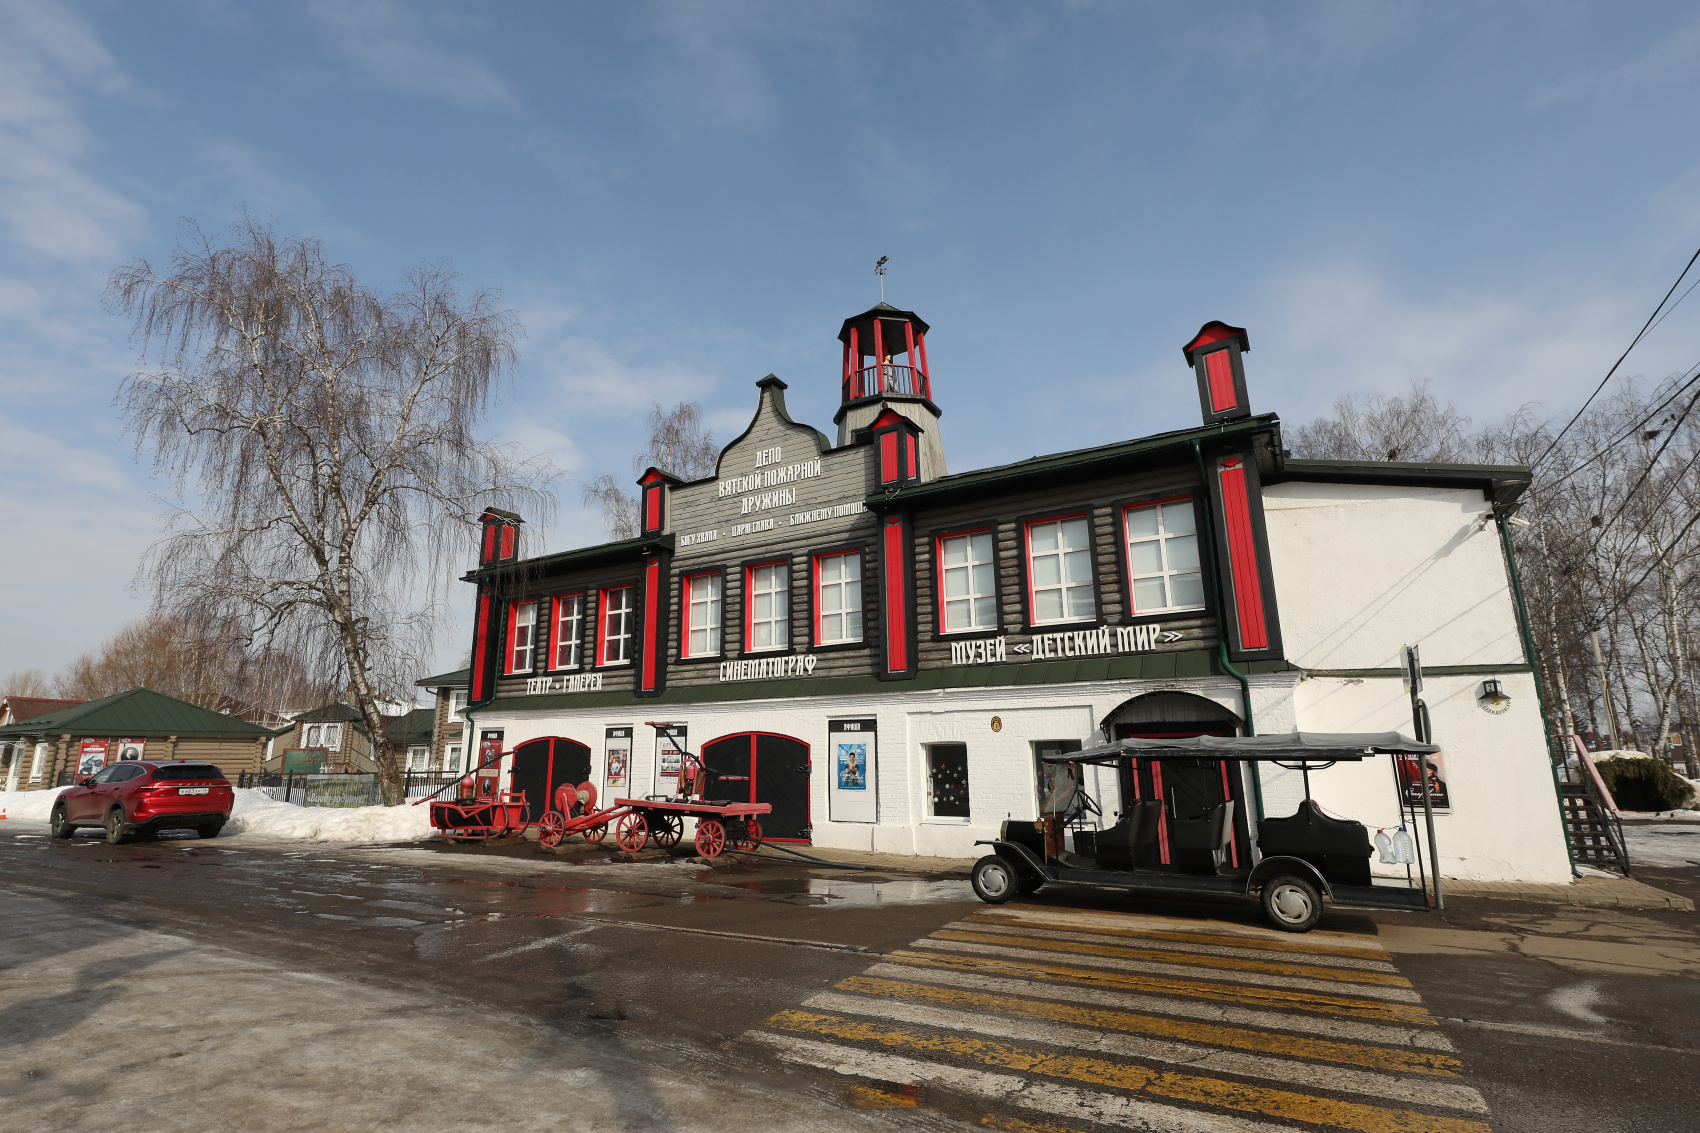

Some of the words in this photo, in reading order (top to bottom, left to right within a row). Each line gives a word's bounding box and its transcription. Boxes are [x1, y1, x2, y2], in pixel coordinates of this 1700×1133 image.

[754, 446, 781, 469] ДЕПО
[718, 470, 762, 498] ВЯТСКОЙ
[764, 456, 821, 488] ПОЖАРНОЙ
[741, 487, 796, 515] ДРУЖИНЫ
[680, 533, 696, 547] БОГУ
[696, 529, 718, 544] ХВАЛА
[731, 522, 751, 537] ЦАРЮ
[752, 518, 774, 533] СЛАВА
[789, 506, 833, 526] БЛИЖНЕМУ
[951, 635, 1007, 665] МУЗЕЙ
[719, 654, 817, 682] СИНЕМАТОГРАФ
[526, 677, 553, 696] ТЕАТР
[562, 673, 603, 693] ГАЛЕРЕЯ
[843, 722, 861, 731] АФИША
